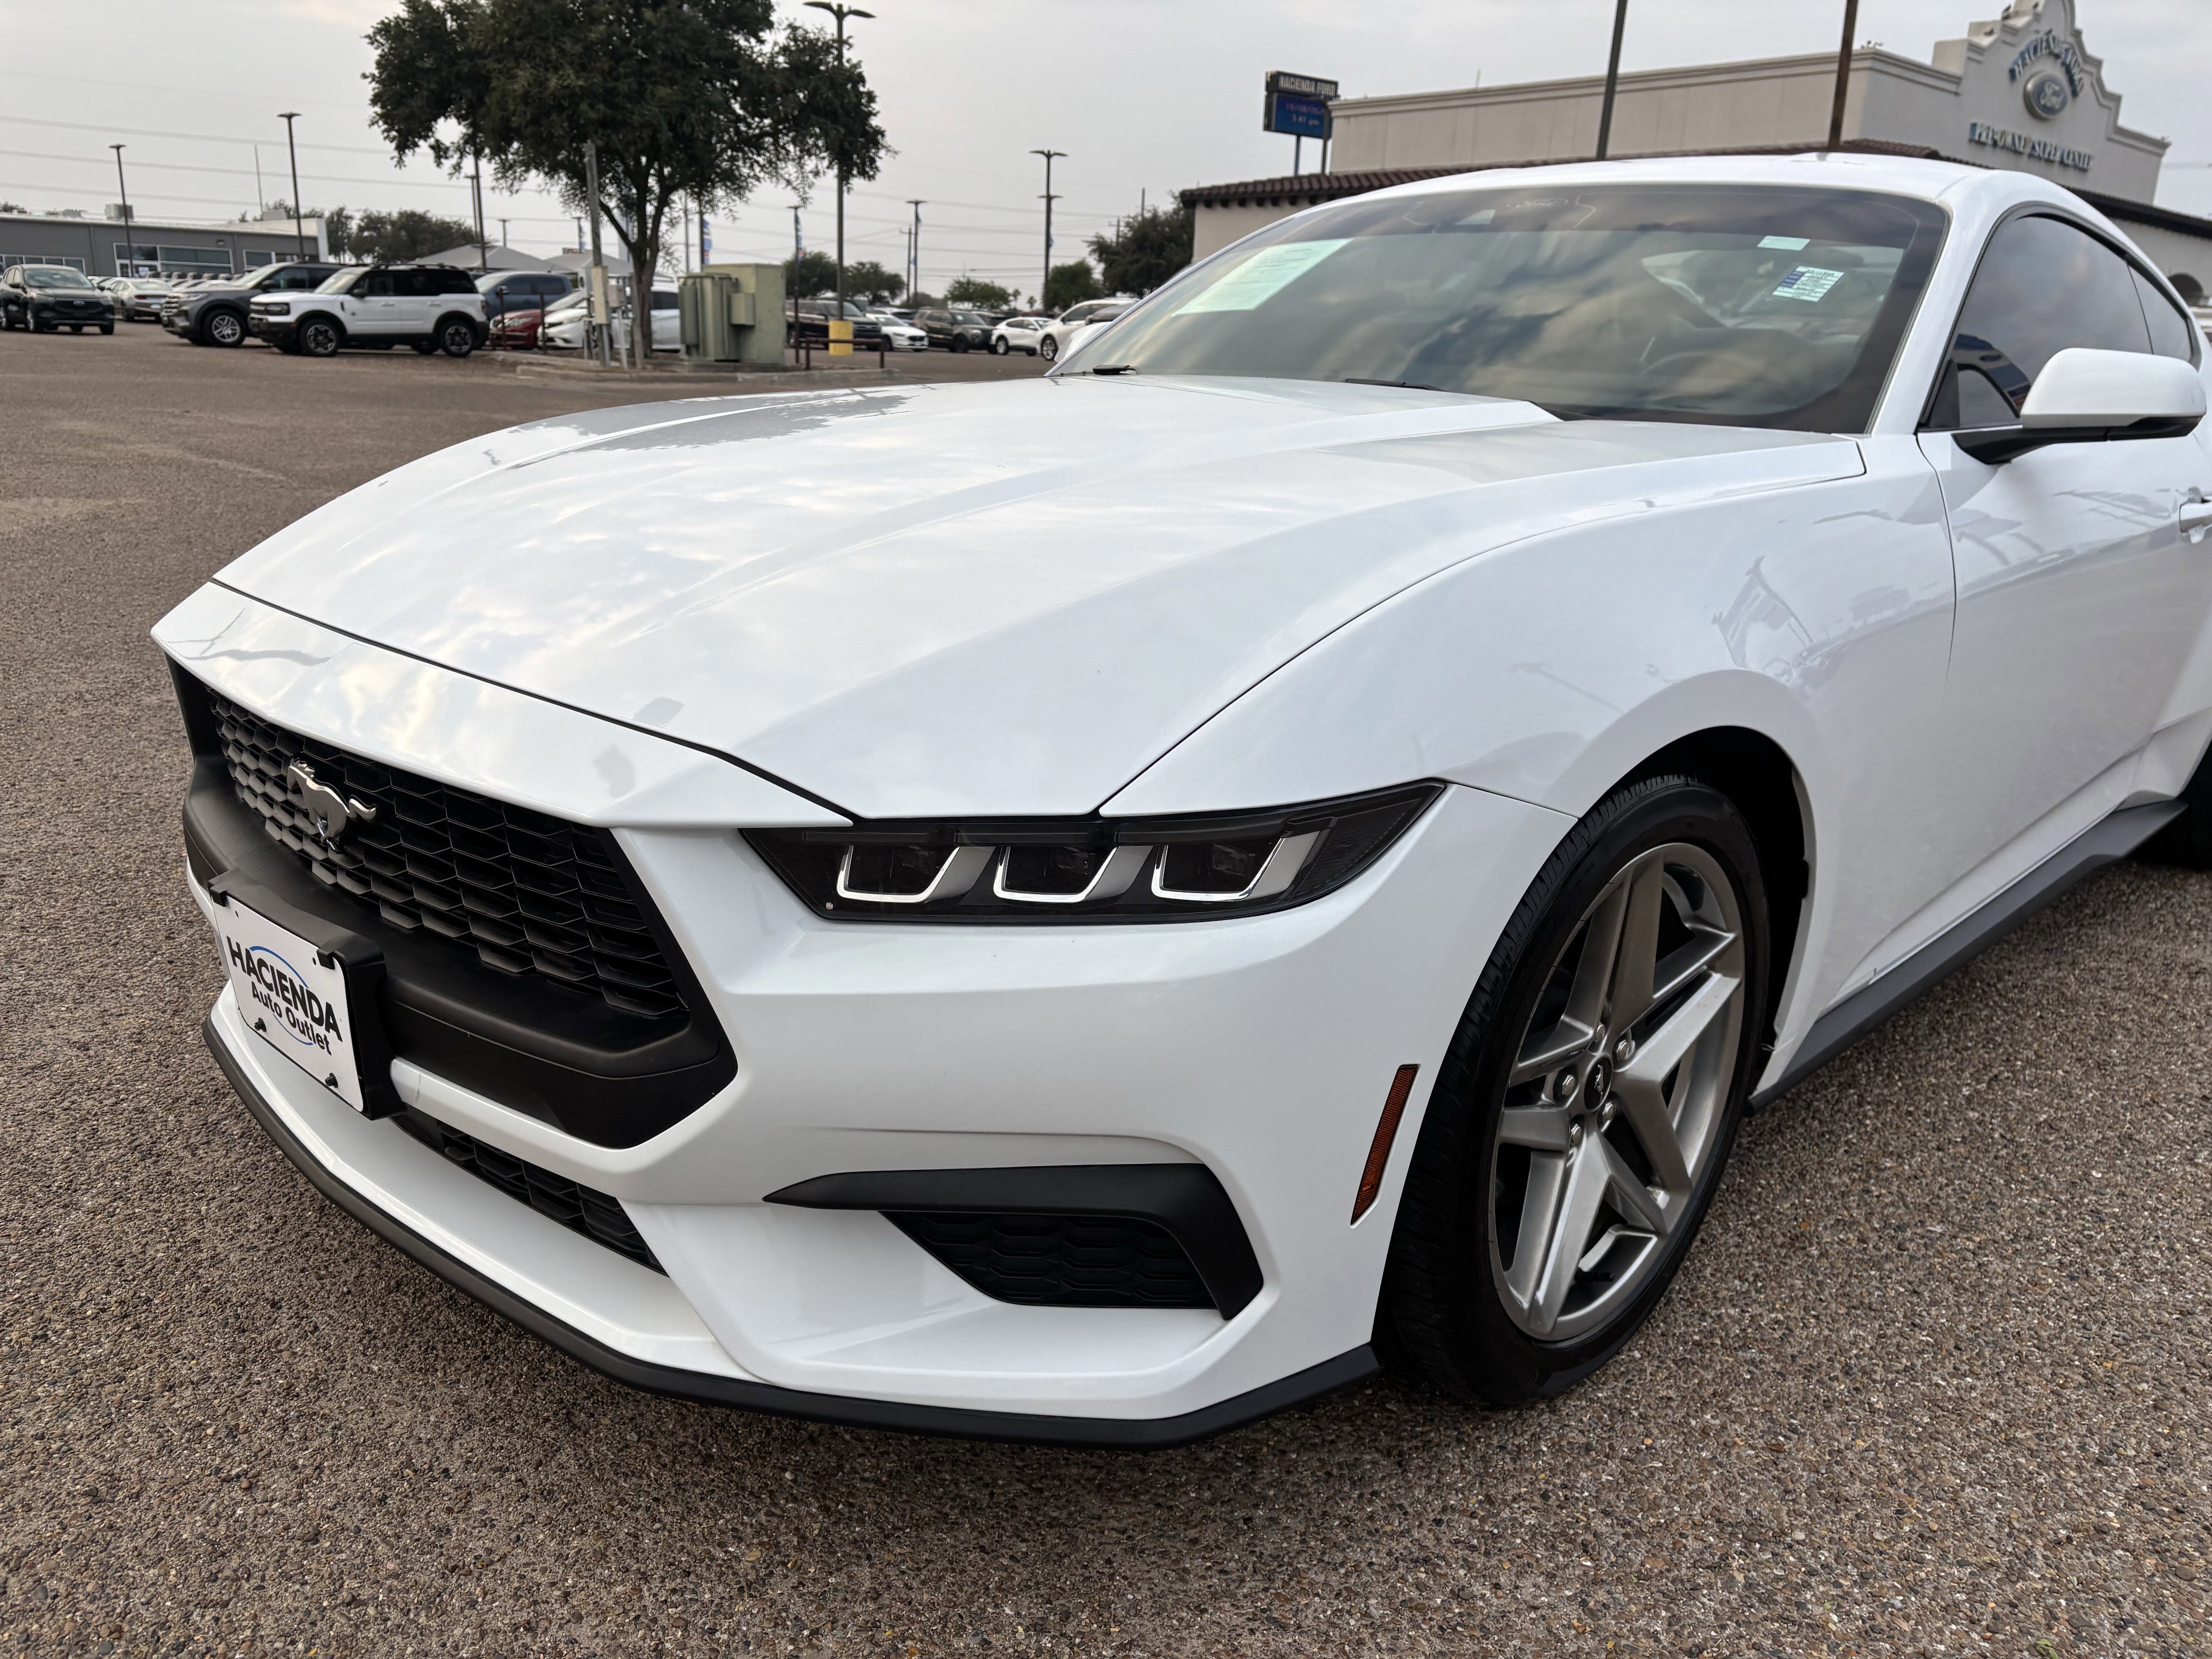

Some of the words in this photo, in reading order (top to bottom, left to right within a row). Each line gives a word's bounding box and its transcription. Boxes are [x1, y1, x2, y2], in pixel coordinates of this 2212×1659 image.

[226, 936, 343, 1042] HACIENDA
[252, 981, 283, 1018] Auto
[285, 1006, 332, 1056] Outlet
